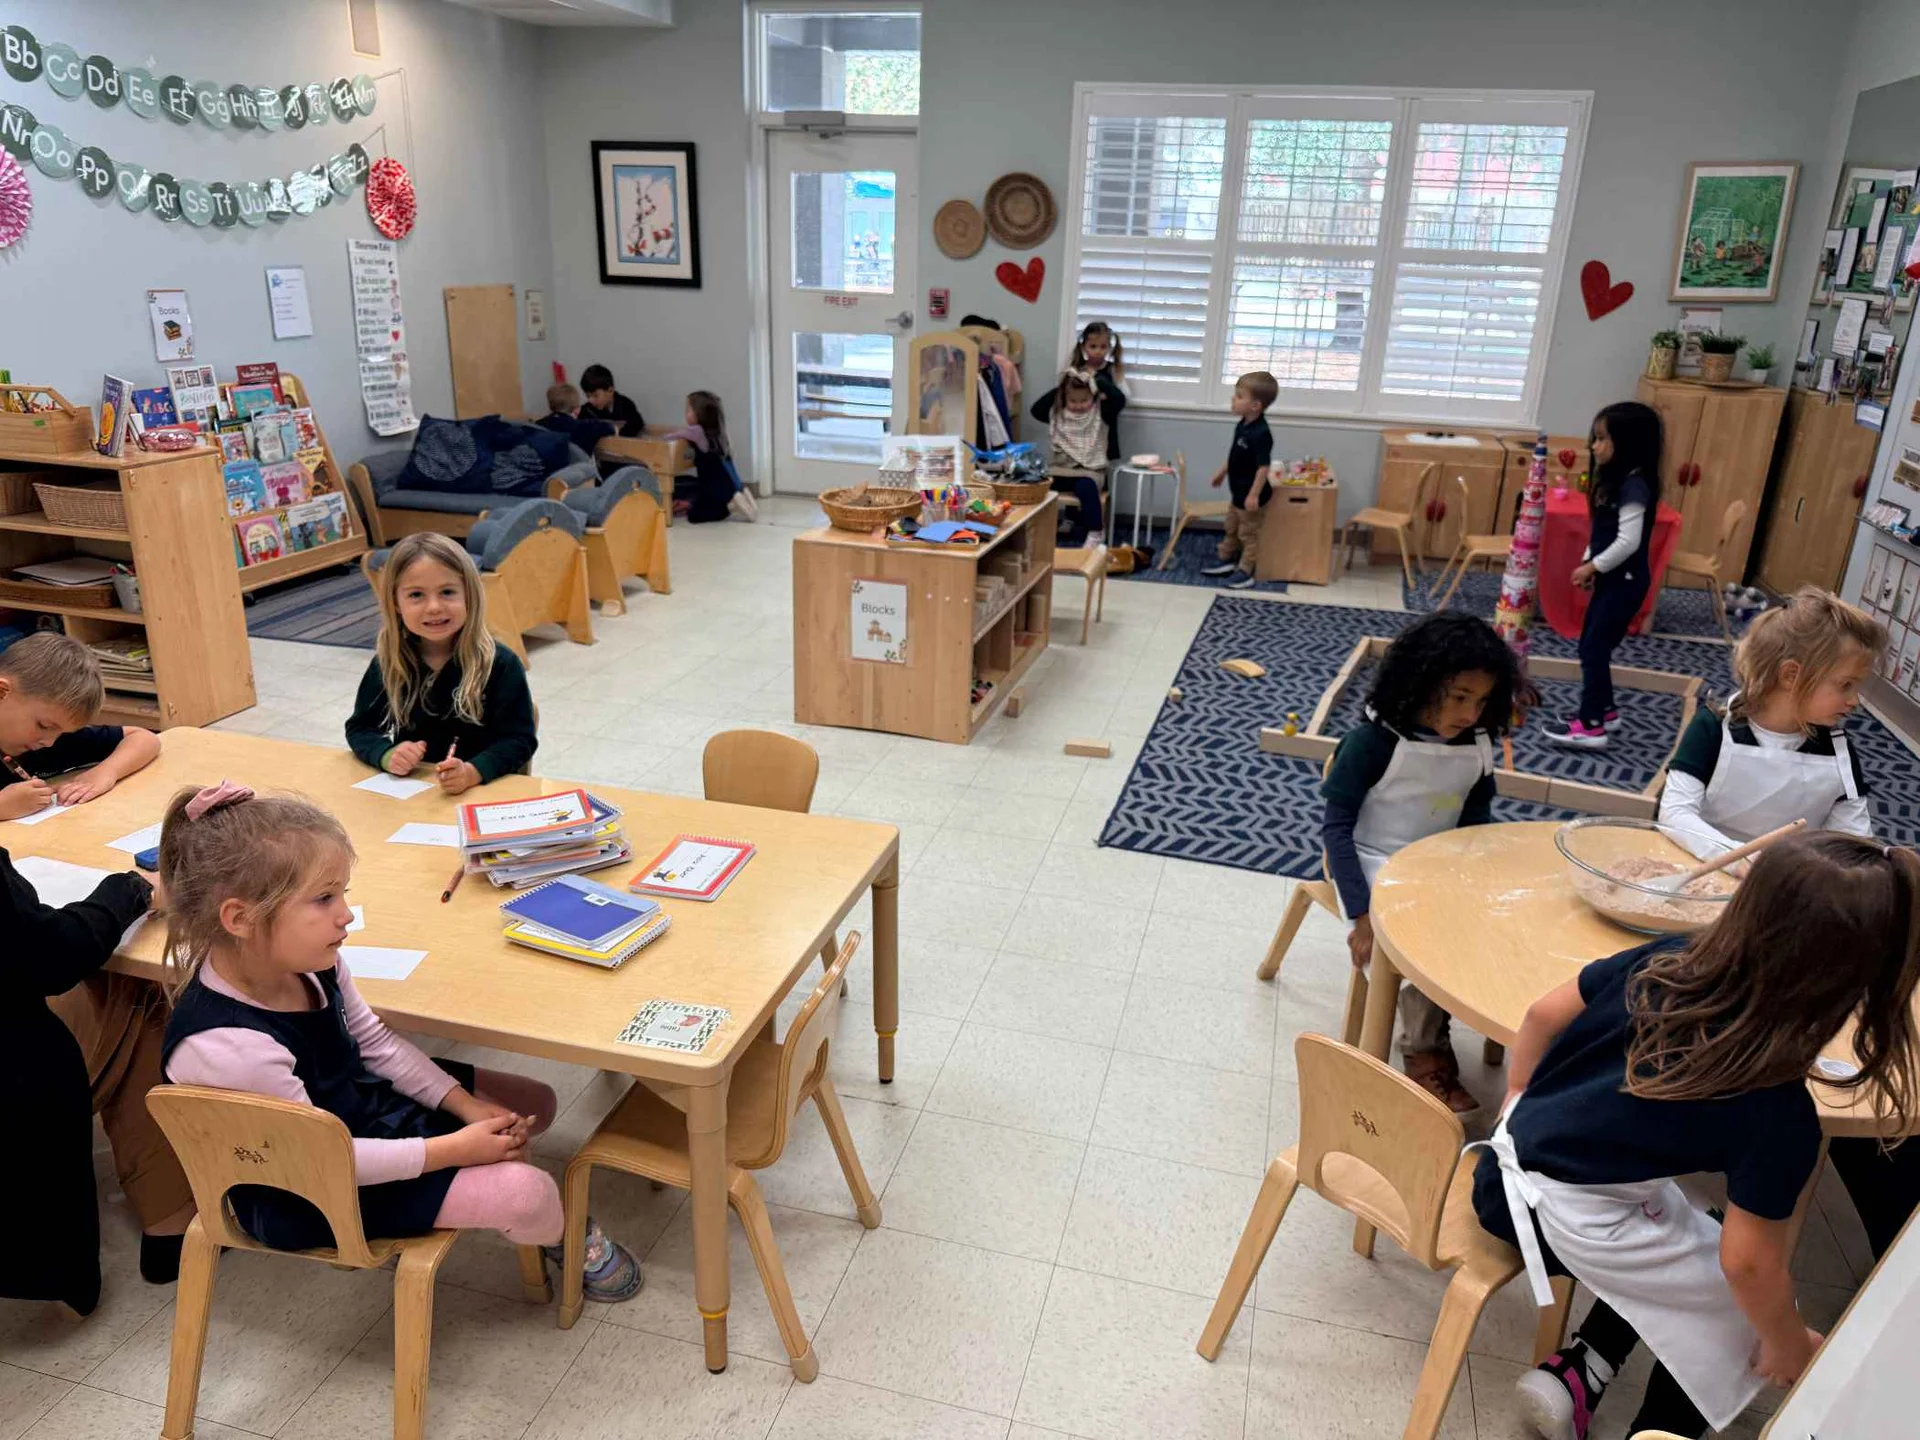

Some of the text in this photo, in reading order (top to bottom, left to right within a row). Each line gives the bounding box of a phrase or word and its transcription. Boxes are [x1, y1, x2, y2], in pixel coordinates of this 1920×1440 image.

[5, 33, 37, 69] Bb
[47, 54, 80, 81] Cc
[86, 64, 119, 96] Dd
[130, 75, 155, 106] Ee
[200, 90, 229, 122] Gg
[230, 92, 257, 118] Hh
[34, 131, 71, 168] Oo
[80, 155, 109, 191] Pp
[155, 184, 177, 210] Rr
[187, 188, 209, 213] Ss
[212, 192, 232, 217] Tt
[238, 192, 266, 215] Uu
[825, 296, 859, 306] FIRE EXIT
[157, 306, 181, 315] Books
[860, 602, 897, 616] Blocks
